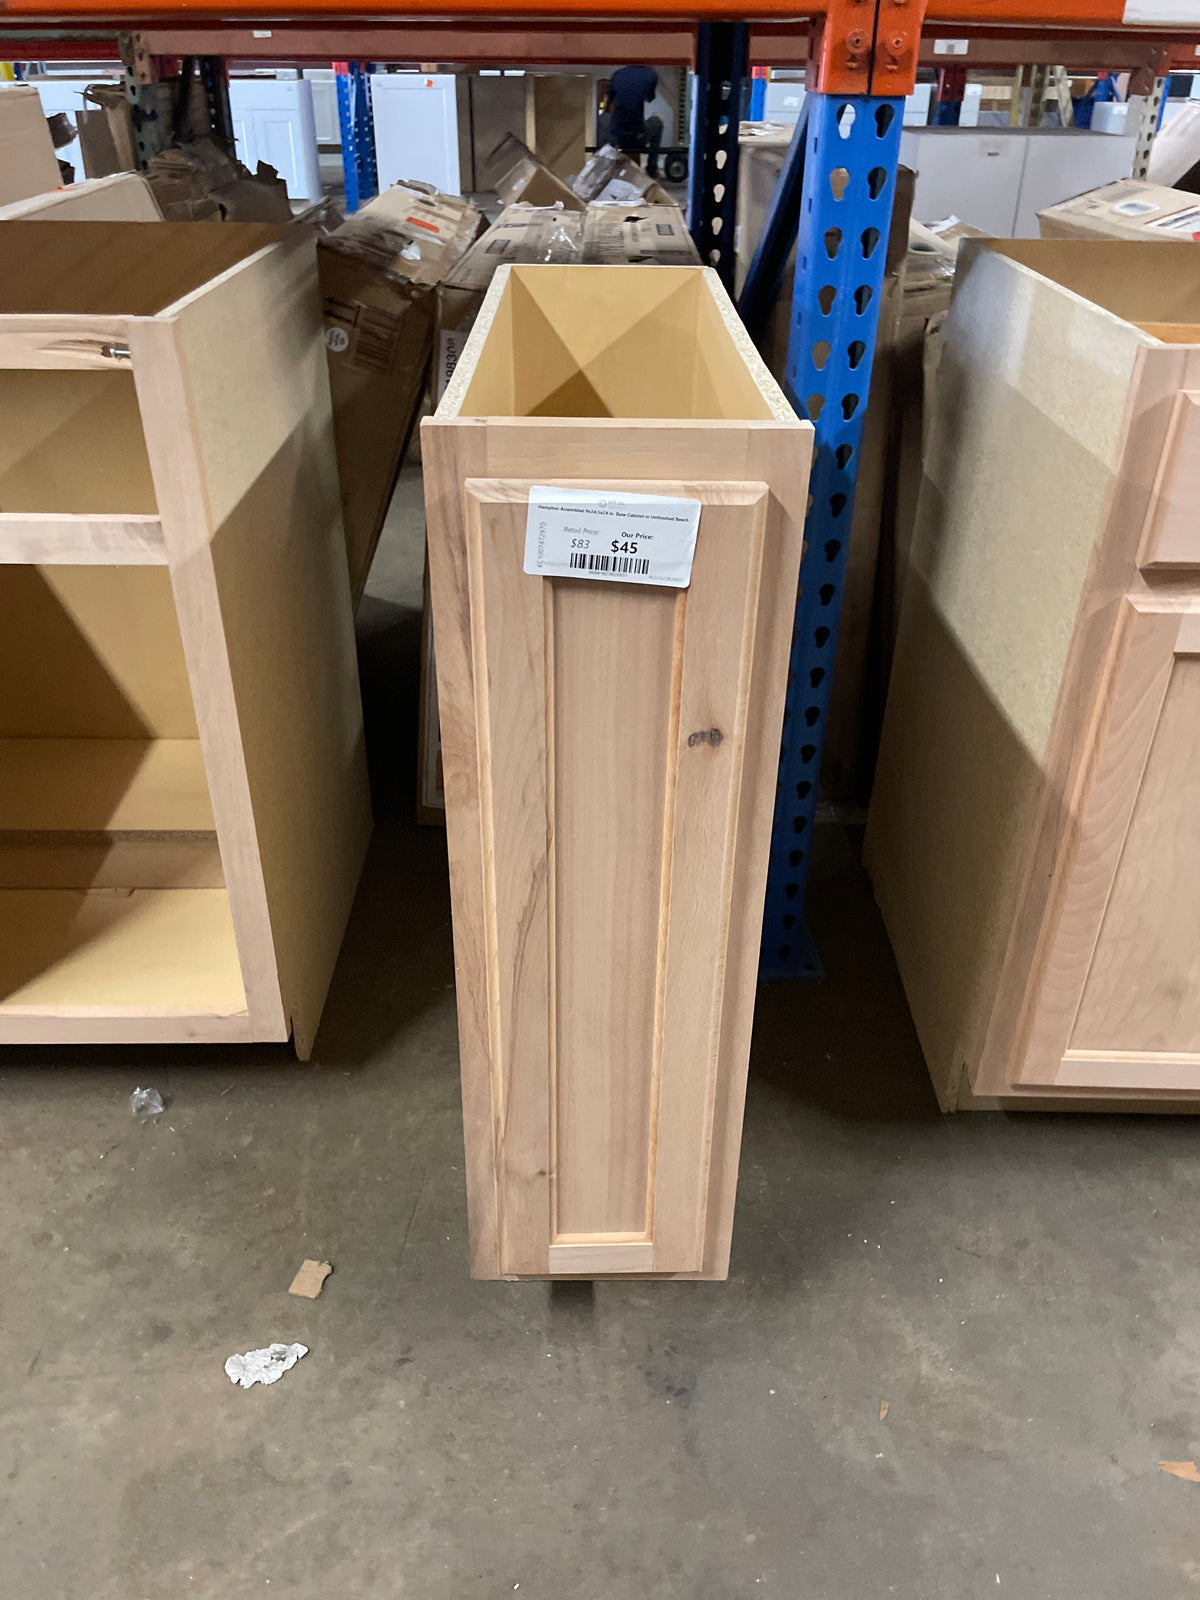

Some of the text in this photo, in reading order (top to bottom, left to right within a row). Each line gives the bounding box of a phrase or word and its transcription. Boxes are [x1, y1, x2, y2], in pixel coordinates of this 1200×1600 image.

[564, 526, 581, 534] Retail
[571, 538, 590, 549] $83
[611, 539, 638, 554] $45
